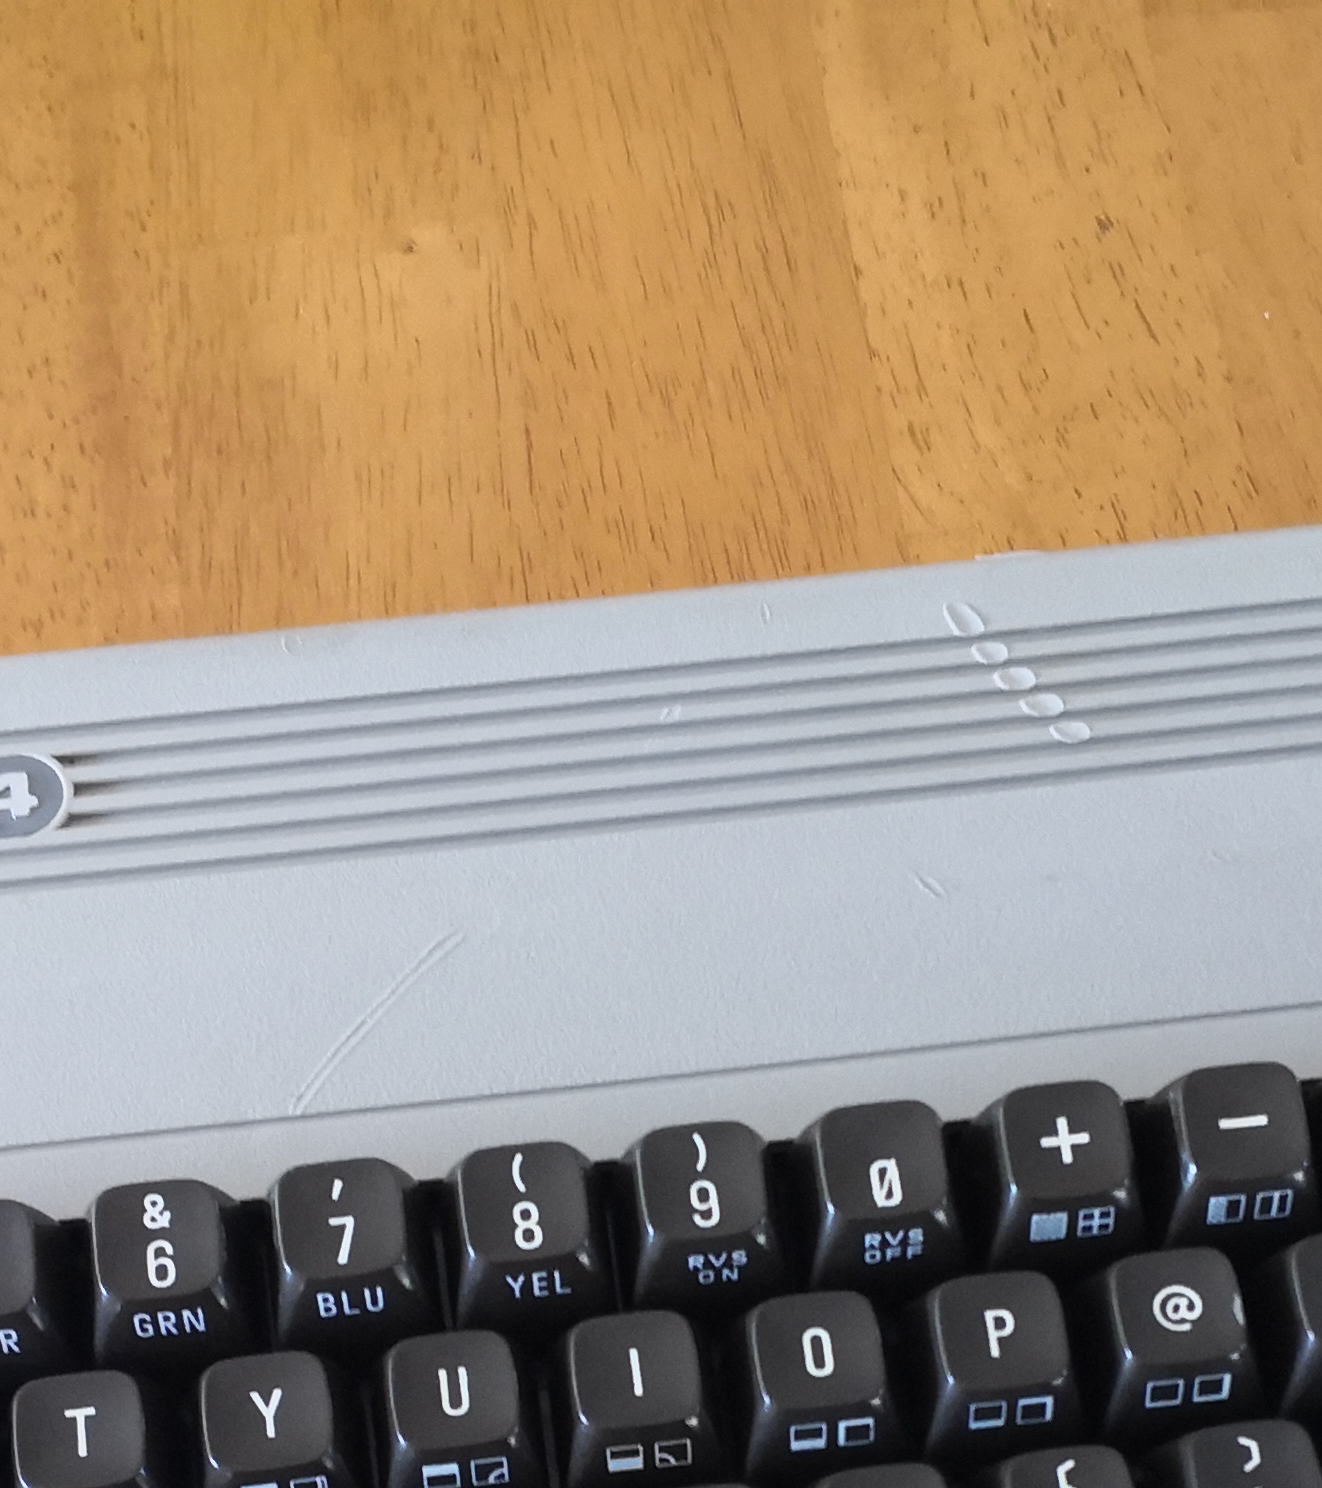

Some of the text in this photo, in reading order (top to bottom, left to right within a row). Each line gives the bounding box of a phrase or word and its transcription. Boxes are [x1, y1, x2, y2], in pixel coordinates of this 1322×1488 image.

[1039, 1116, 1091, 1164] +
[142, 1193, 172, 1230] &
[512, 1200, 544, 1250] 8
[689, 1179, 721, 1228] 9
[328, 1215, 355, 1265] 7
[687, 1249, 748, 1272] RVS
[863, 1228, 925, 1250] RVS
[863, 1244, 925, 1264] OFF
[146, 1239, 177, 1289] 6
[505, 1269, 571, 1299] YEL
[697, 1265, 740, 1285] ON
[132, 1307, 206, 1338] GRN
[316, 1286, 384, 1318] BLU
[1152, 1284, 1203, 1332] @
[802, 1327, 835, 1378] O
[983, 1308, 1015, 1358] P
[437, 1365, 470, 1417] U
[628, 1348, 642, 1397] I
[63, 1406, 96, 1458] T
[249, 1387, 283, 1439] Y
